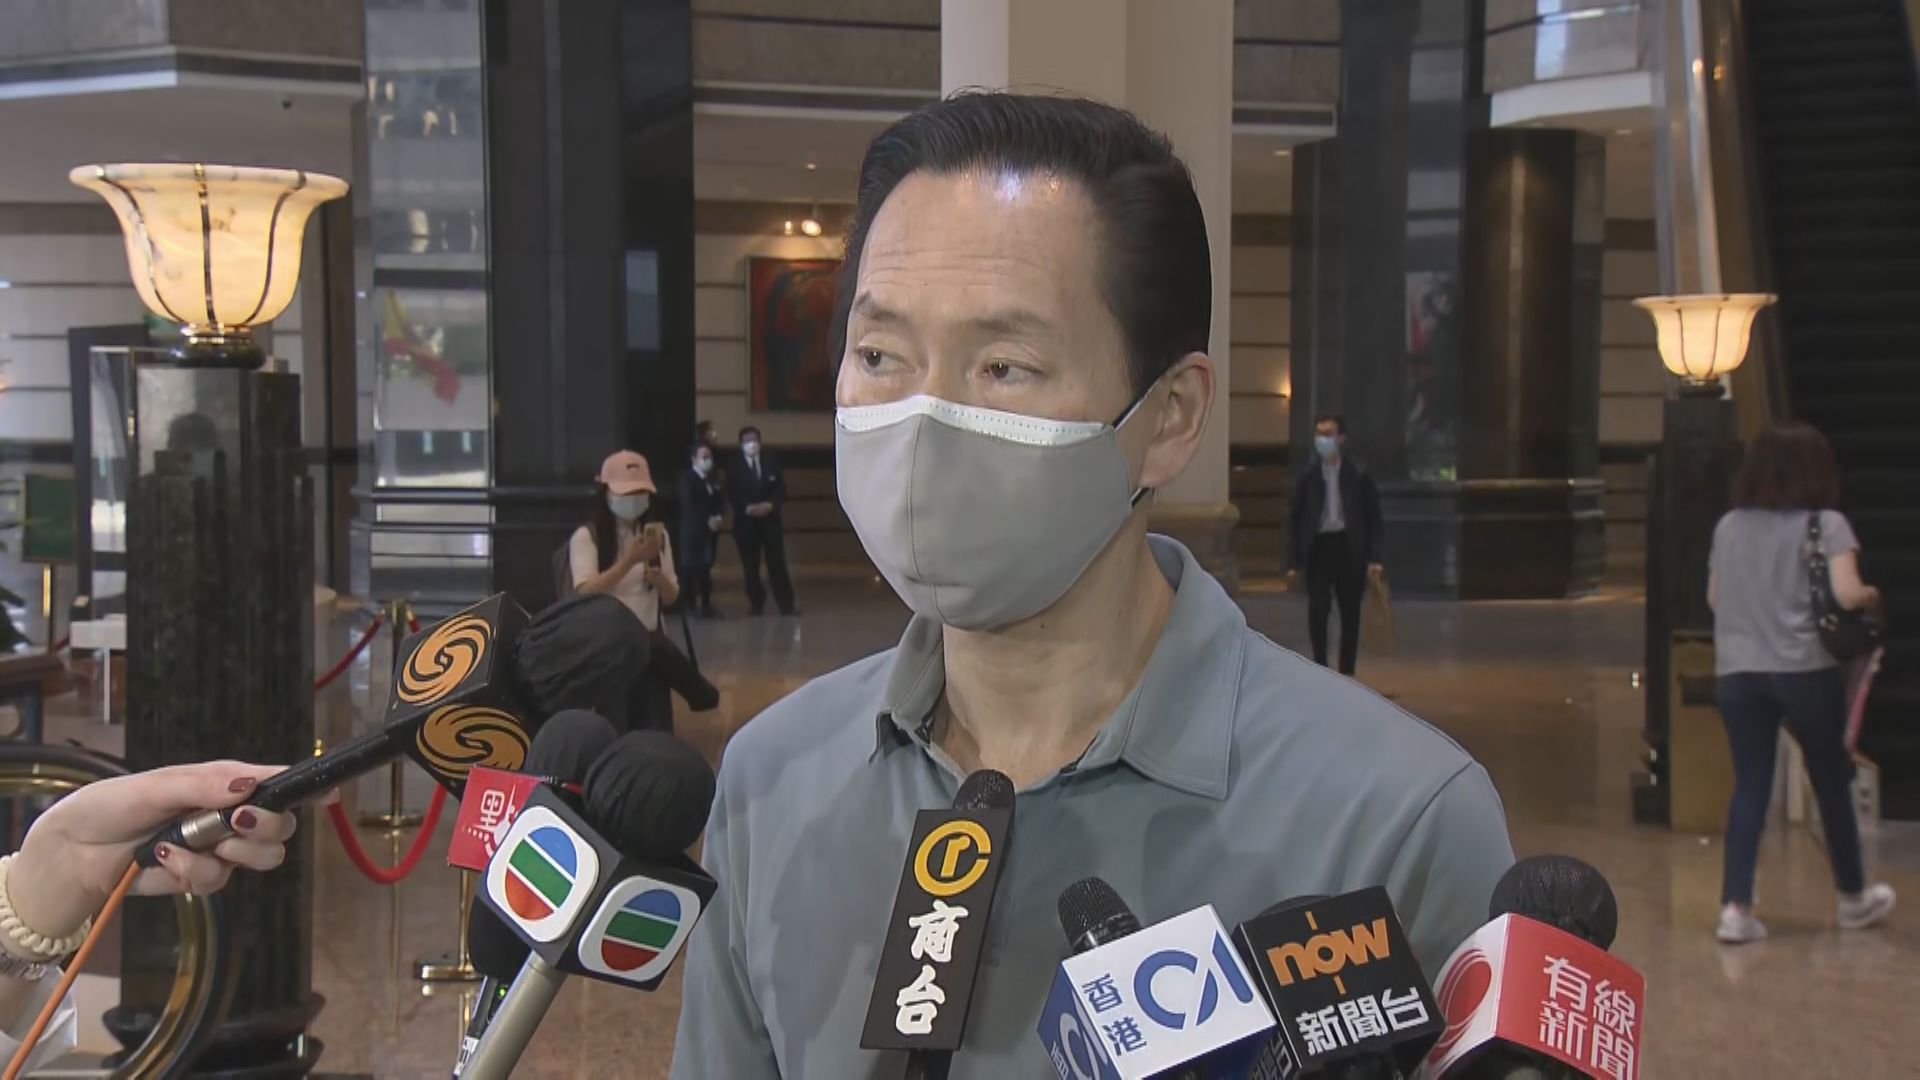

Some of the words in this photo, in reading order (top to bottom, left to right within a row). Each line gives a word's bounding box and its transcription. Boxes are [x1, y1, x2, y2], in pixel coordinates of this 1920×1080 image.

[896, 900, 969, 1035] 商台
[1543, 955, 1635, 1042] 有線
[1081, 973, 1148, 1057] 香港
[1296, 987, 1429, 1056] 新聞台
[1539, 1000, 1634, 1080] 新聞
